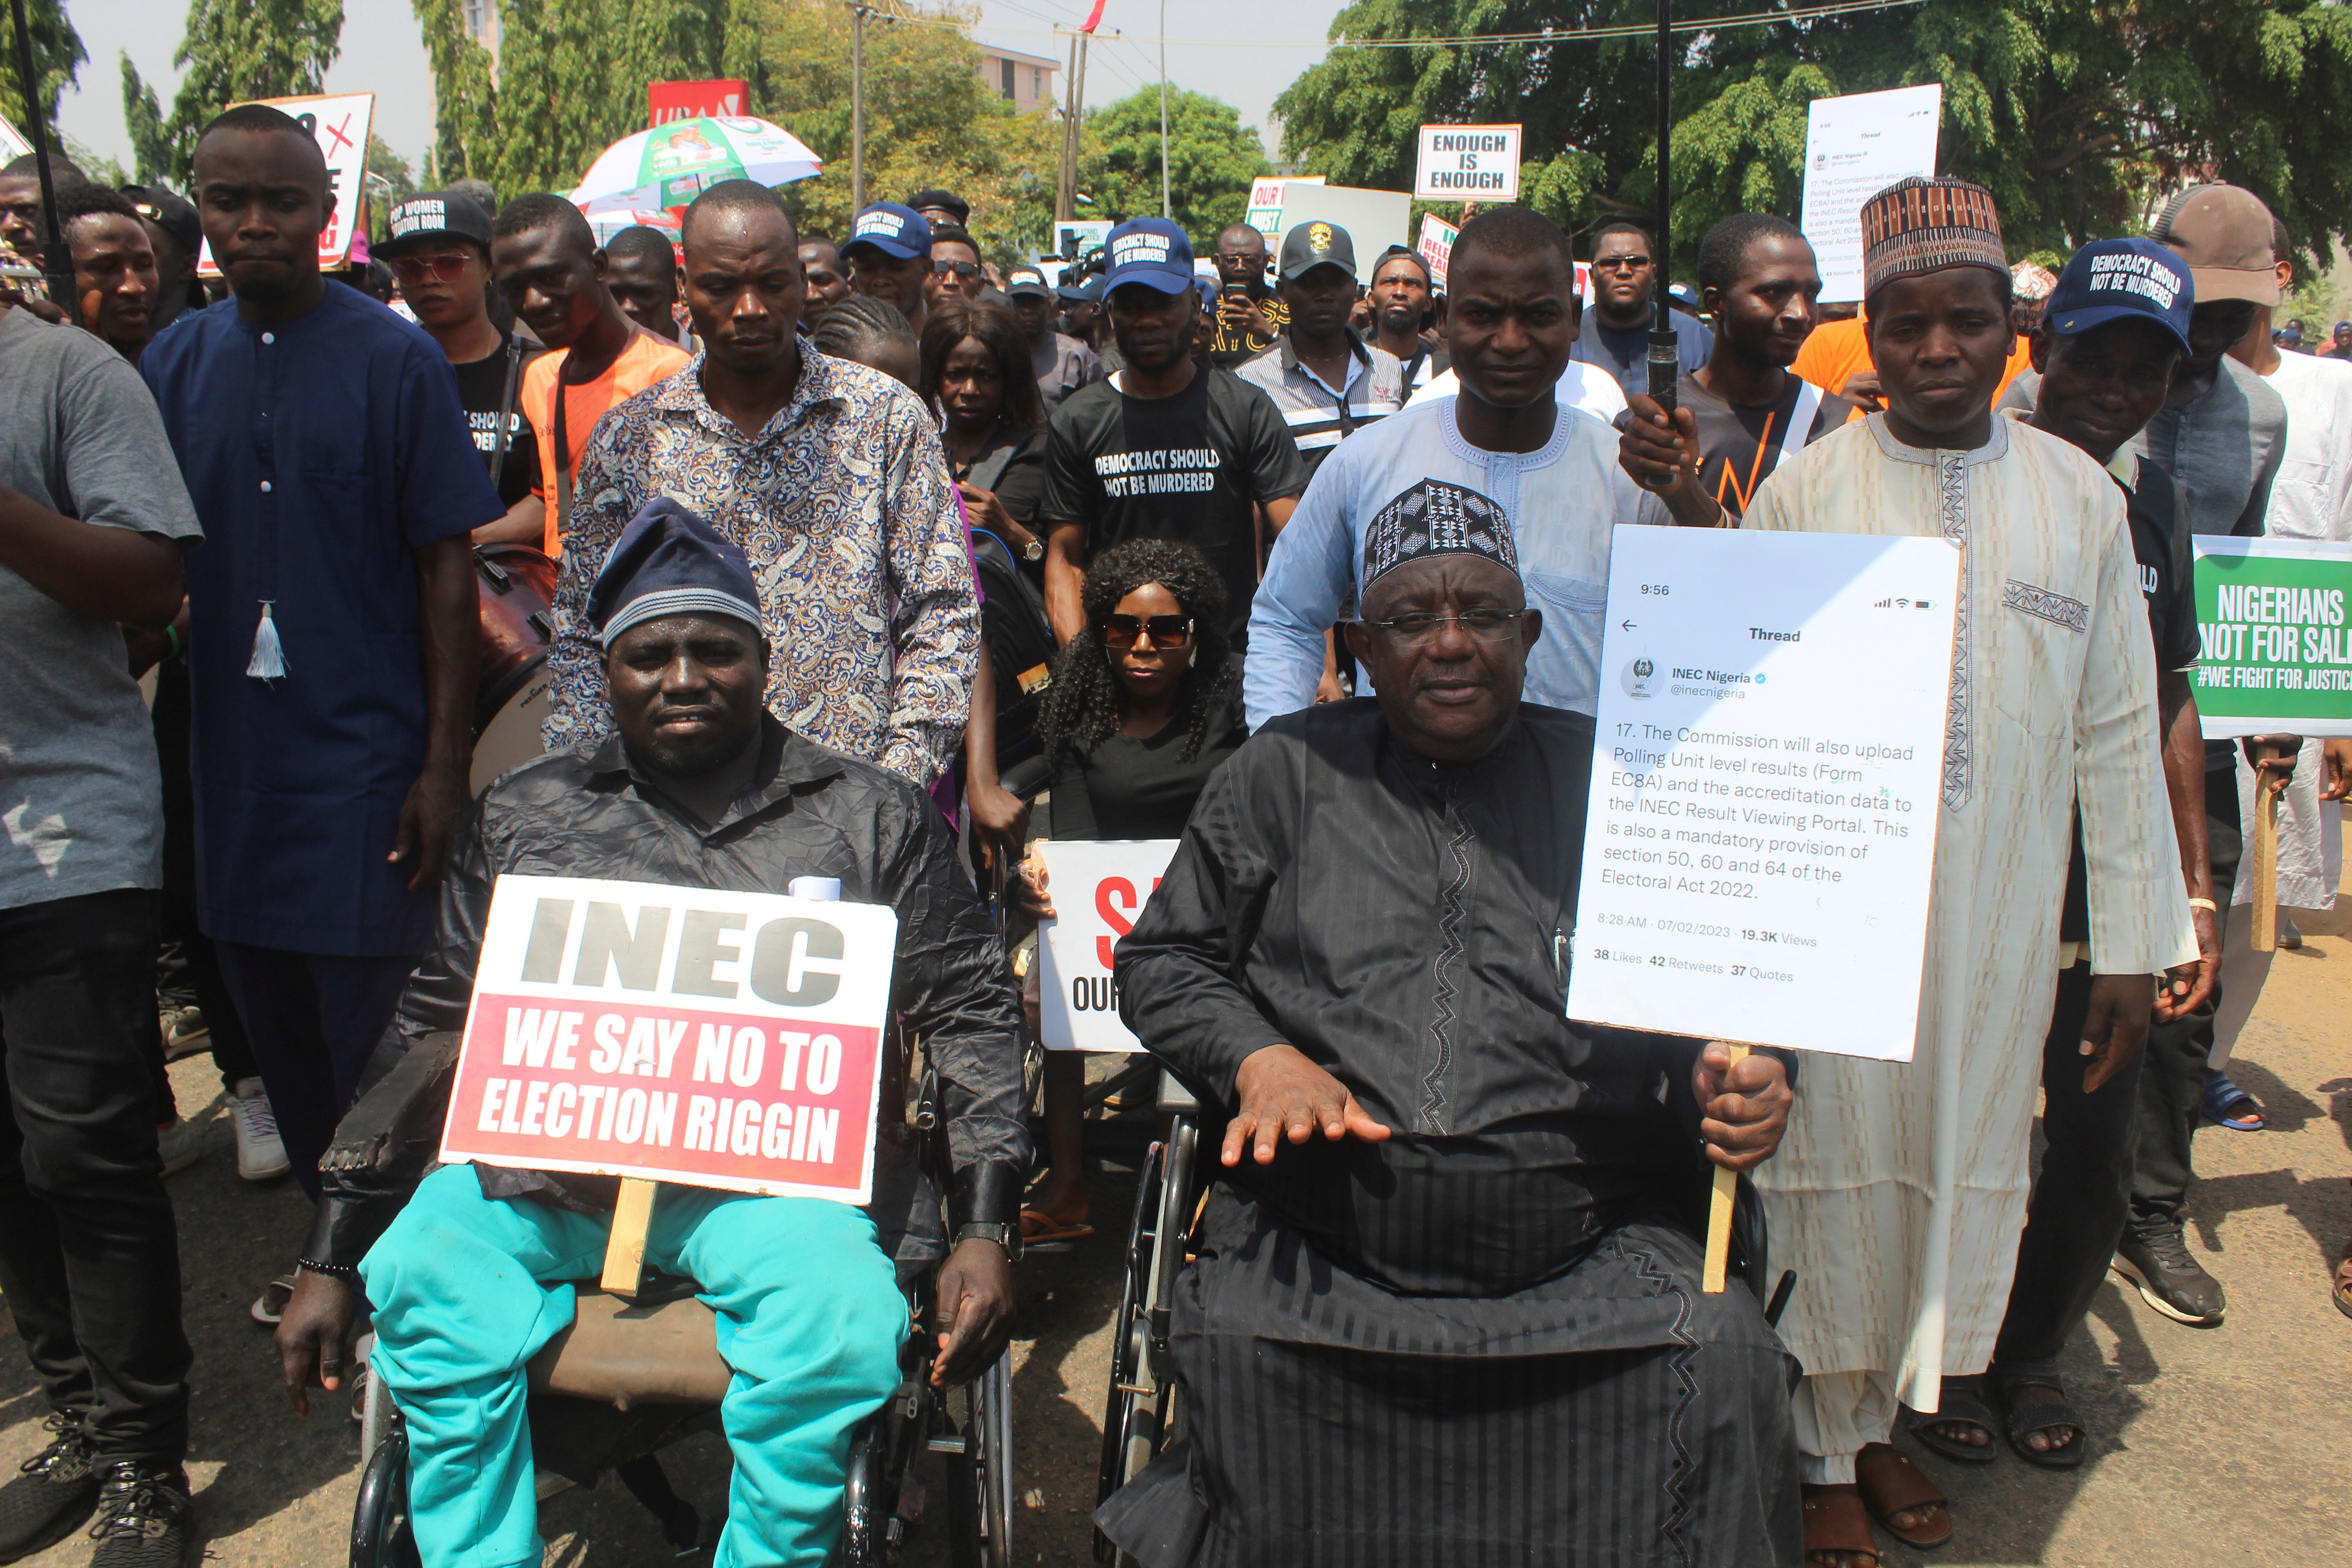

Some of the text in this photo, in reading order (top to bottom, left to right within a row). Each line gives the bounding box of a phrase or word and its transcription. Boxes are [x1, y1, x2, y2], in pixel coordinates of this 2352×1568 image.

[1433, 135, 1506, 152] ENOUGH
[1459, 154, 1477, 170] IS
[1431, 172, 1504, 189] ENOUGH
[1834, 176, 1873, 185] Commission
[1900, 169, 1923, 178] upload
[404, 198, 446, 216] WOMEN
[1255, 186, 1279, 206] OUR
[420, 213, 447, 230] ROOM
[882, 211, 905, 229] SHOULD
[1250, 211, 1280, 232] MUST
[1112, 232, 1145, 255] DEMOCRACY
[1145, 232, 1171, 251] SHOULD
[1115, 251, 1124, 269] NOT
[1123, 248, 1132, 264] BE
[1132, 247, 1167, 264] MURDERED
[2090, 254, 2182, 295] DEMOCRACY SHOULD
[2089, 273, 2175, 310] NOT BE MURDERED
[1095, 449, 1220, 475] DEMOCRACY SHOULD
[1103, 472, 1215, 497] NOT BE MURDERED
[1641, 584, 1670, 596] 9:56
[2217, 584, 2345, 627] NIGERIANS
[1749, 627, 1801, 642] Thread
[2197, 622, 2247, 661] NOT
[2251, 625, 2299, 663] FOR
[1672, 668, 1751, 684] INEC Nigeria
[2197, 666, 2231, 688] #WE
[2233, 666, 2274, 689] FIGHT
[2275, 668, 2302, 690] FOR
[1671, 684, 1745, 700] @inecnigeria
[1617, 723, 1913, 760] 17. The Commission will also upload
[1614, 747, 1862, 781] Polling Unit level results (Form
[1611, 771, 1912, 812] EC8A) and the accreditation data to
[1608, 796, 1909, 838] the INEC Result Viewing Portal. This
[1607, 820, 1869, 859] is also a mandatory provision of
[1604, 848, 1842, 882] section 50, 60 and 64 of the
[1602, 868, 1758, 899] Electoral Act 2022.
[1597, 912, 1818, 948] 8:28 AM 07/02/2023 19.3K Views
[520, 897, 845, 1008] INEC
[1593, 948, 1794, 982] 38 Likes 42 Retweets 37 Quotes
[501, 1007, 843, 1096] WE SAY NO TO
[476, 1078, 840, 1165] ELECTION RIGGIN
